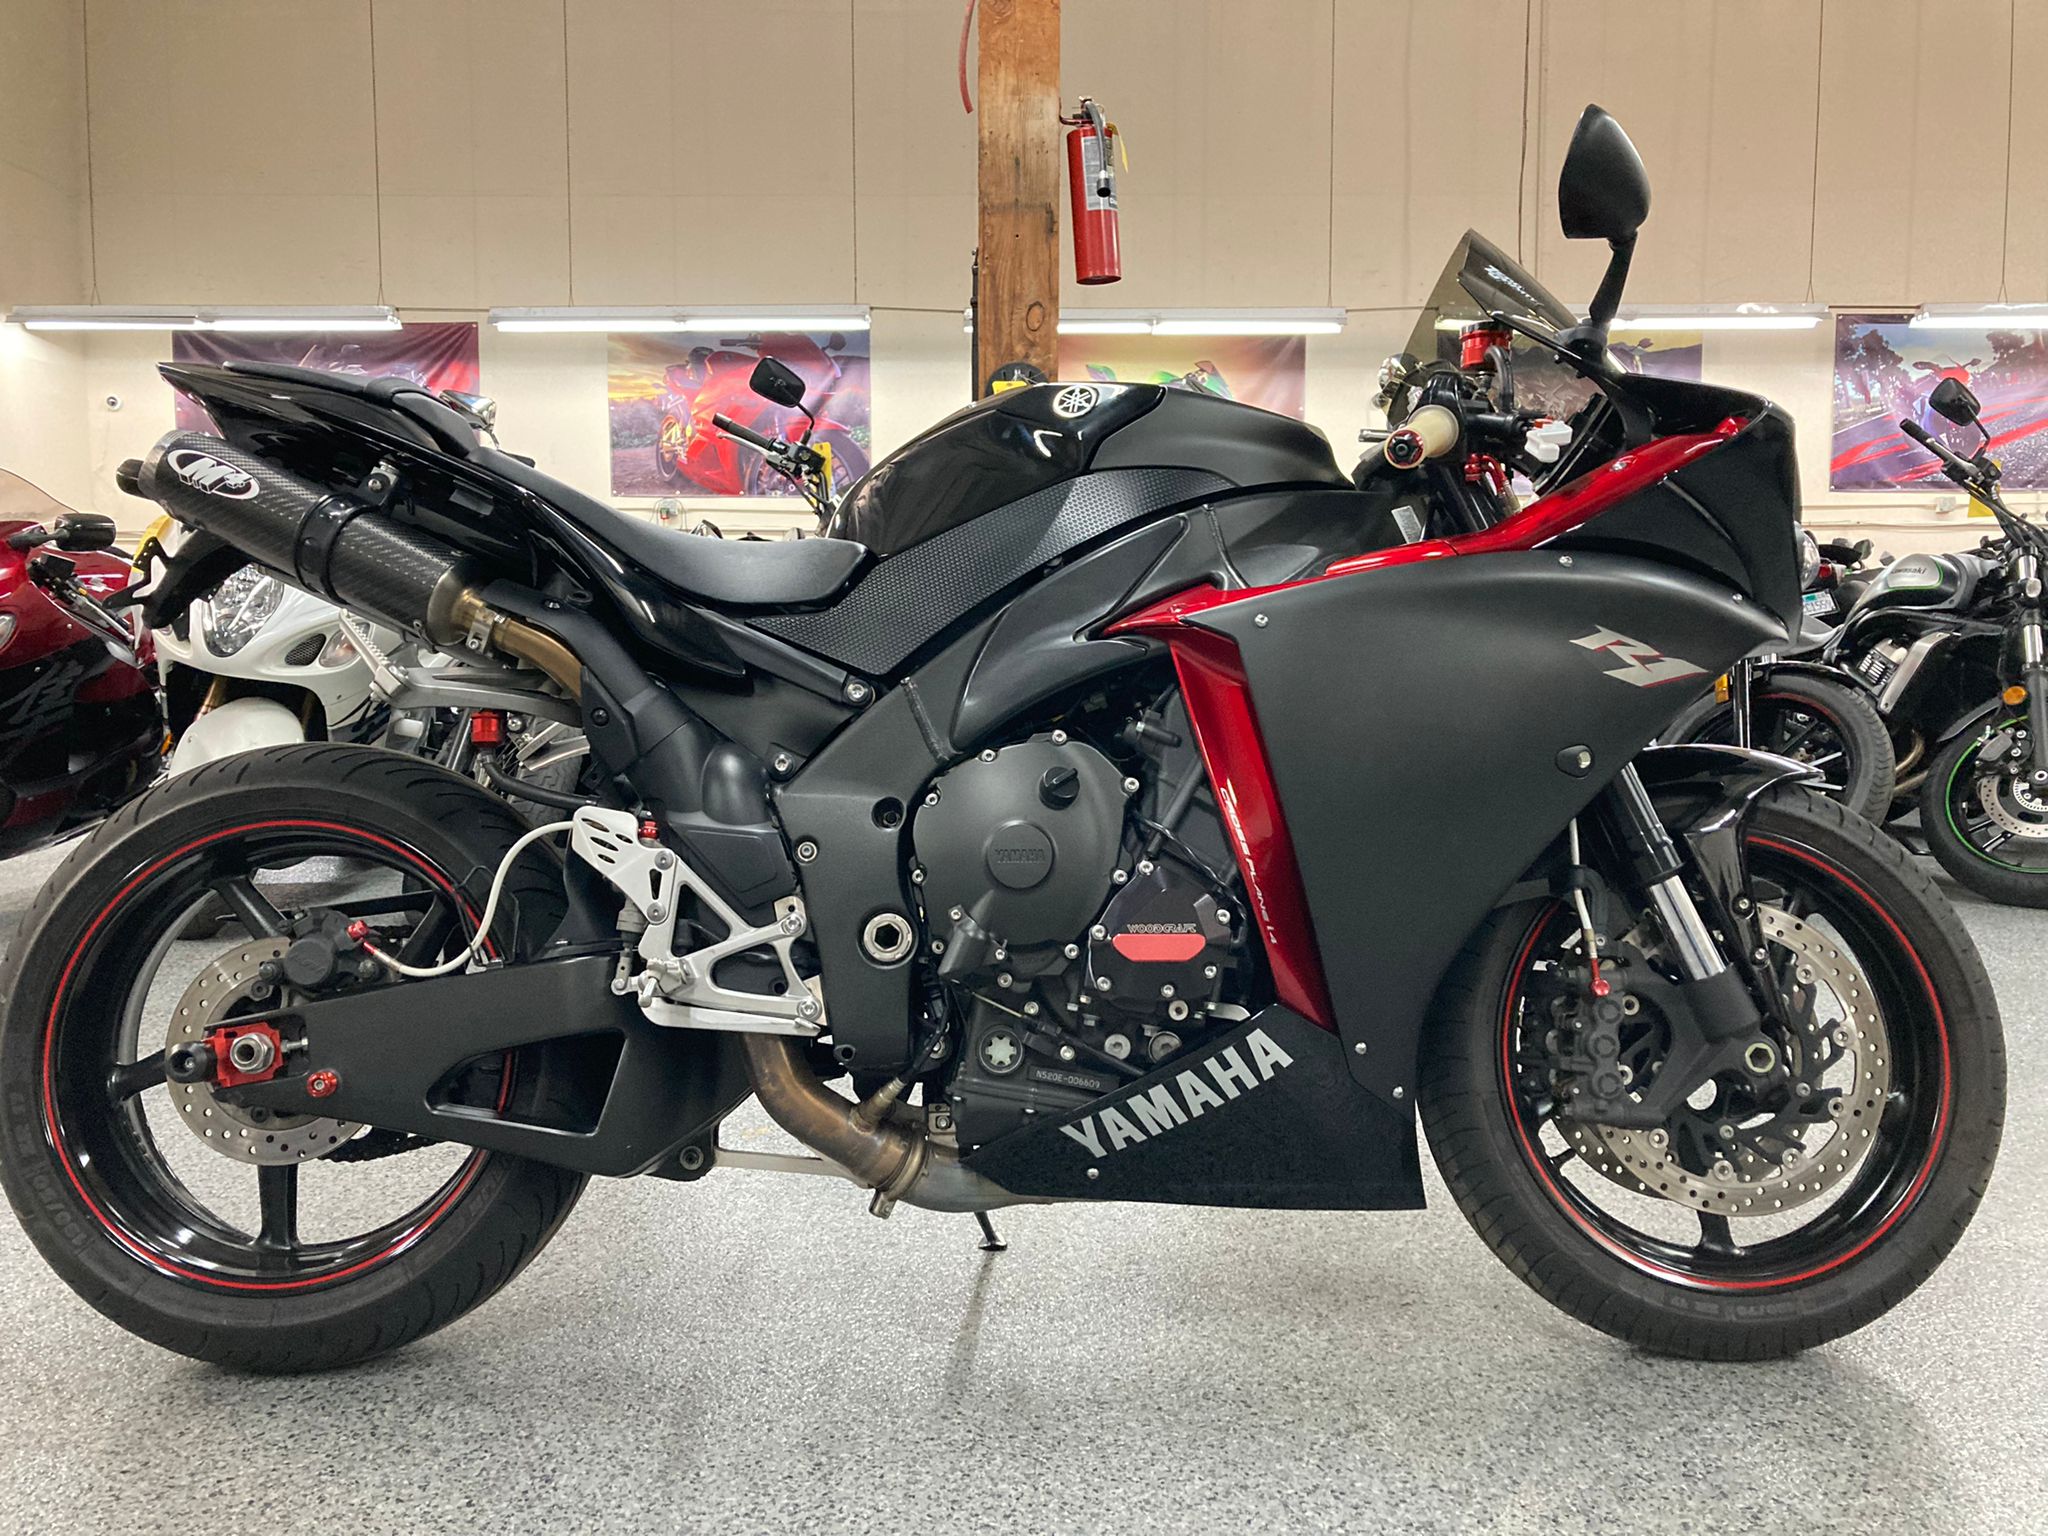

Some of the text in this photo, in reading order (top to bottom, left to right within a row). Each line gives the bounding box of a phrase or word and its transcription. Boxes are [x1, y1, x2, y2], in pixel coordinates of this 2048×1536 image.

[179, 457, 253, 494] M4
[993, 848, 1046, 862] YAMAHA
[1220, 787, 1250, 857] CROSS
[1245, 857, 1270, 923] PLANE
[1127, 923, 1197, 934] WOODCRAFT
[1059, 1028, 1294, 1158] YAMAHA
